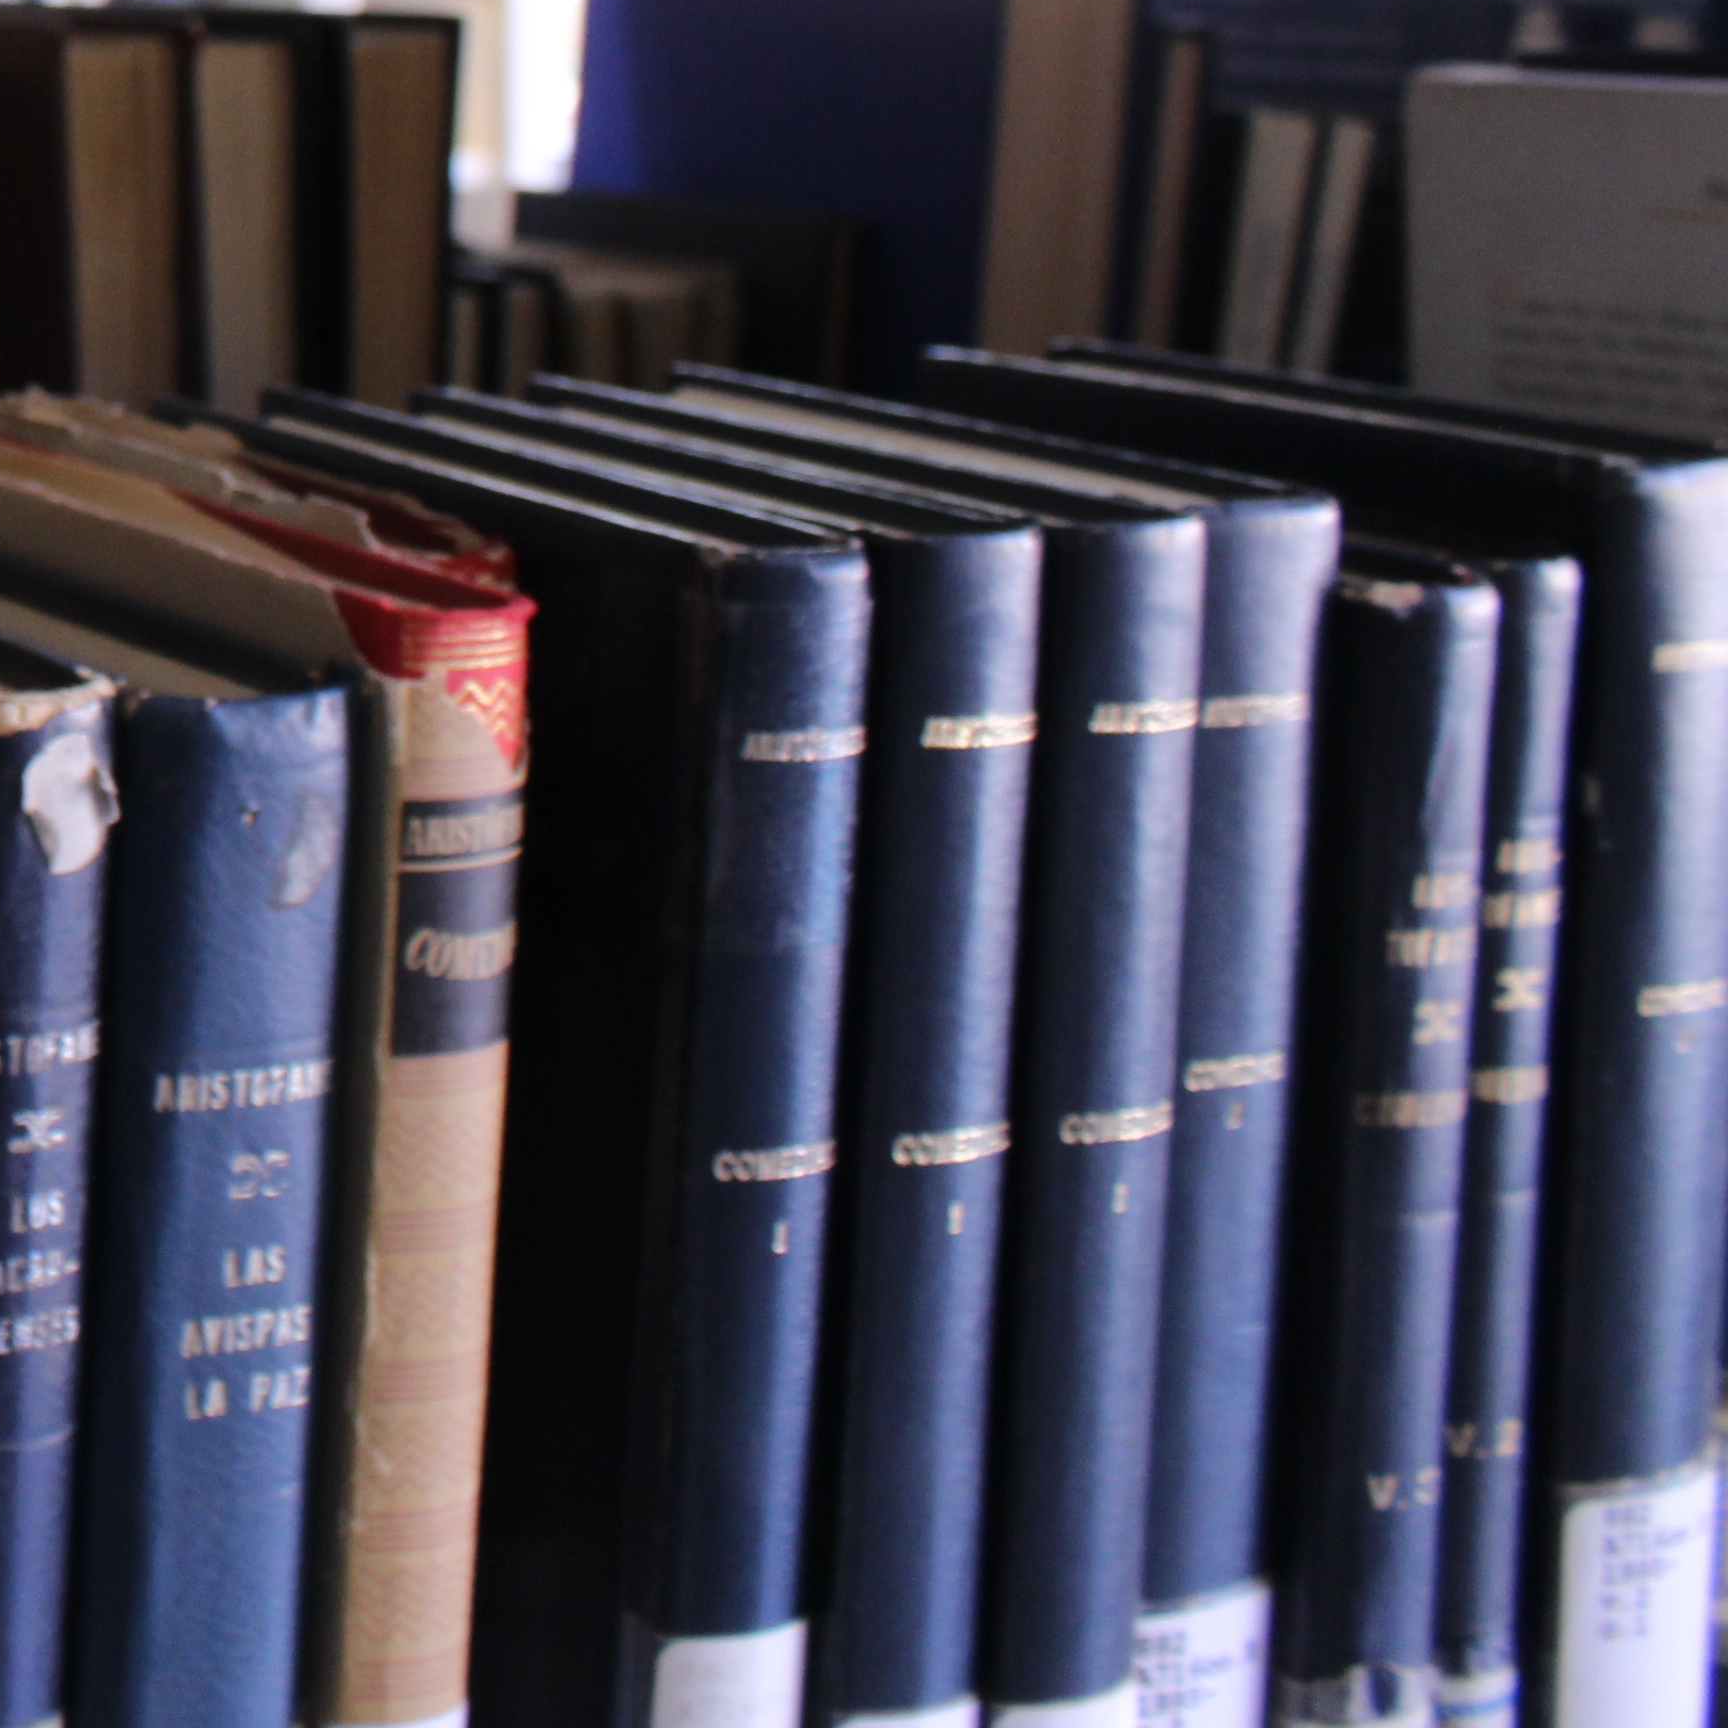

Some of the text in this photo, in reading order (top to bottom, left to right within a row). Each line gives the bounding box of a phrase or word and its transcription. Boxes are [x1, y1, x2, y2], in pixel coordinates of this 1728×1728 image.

[222, 1242, 287, 1290] LAS
[180, 1302, 313, 1360] AVISPAS
[185, 1363, 313, 1421] LA PAZ
